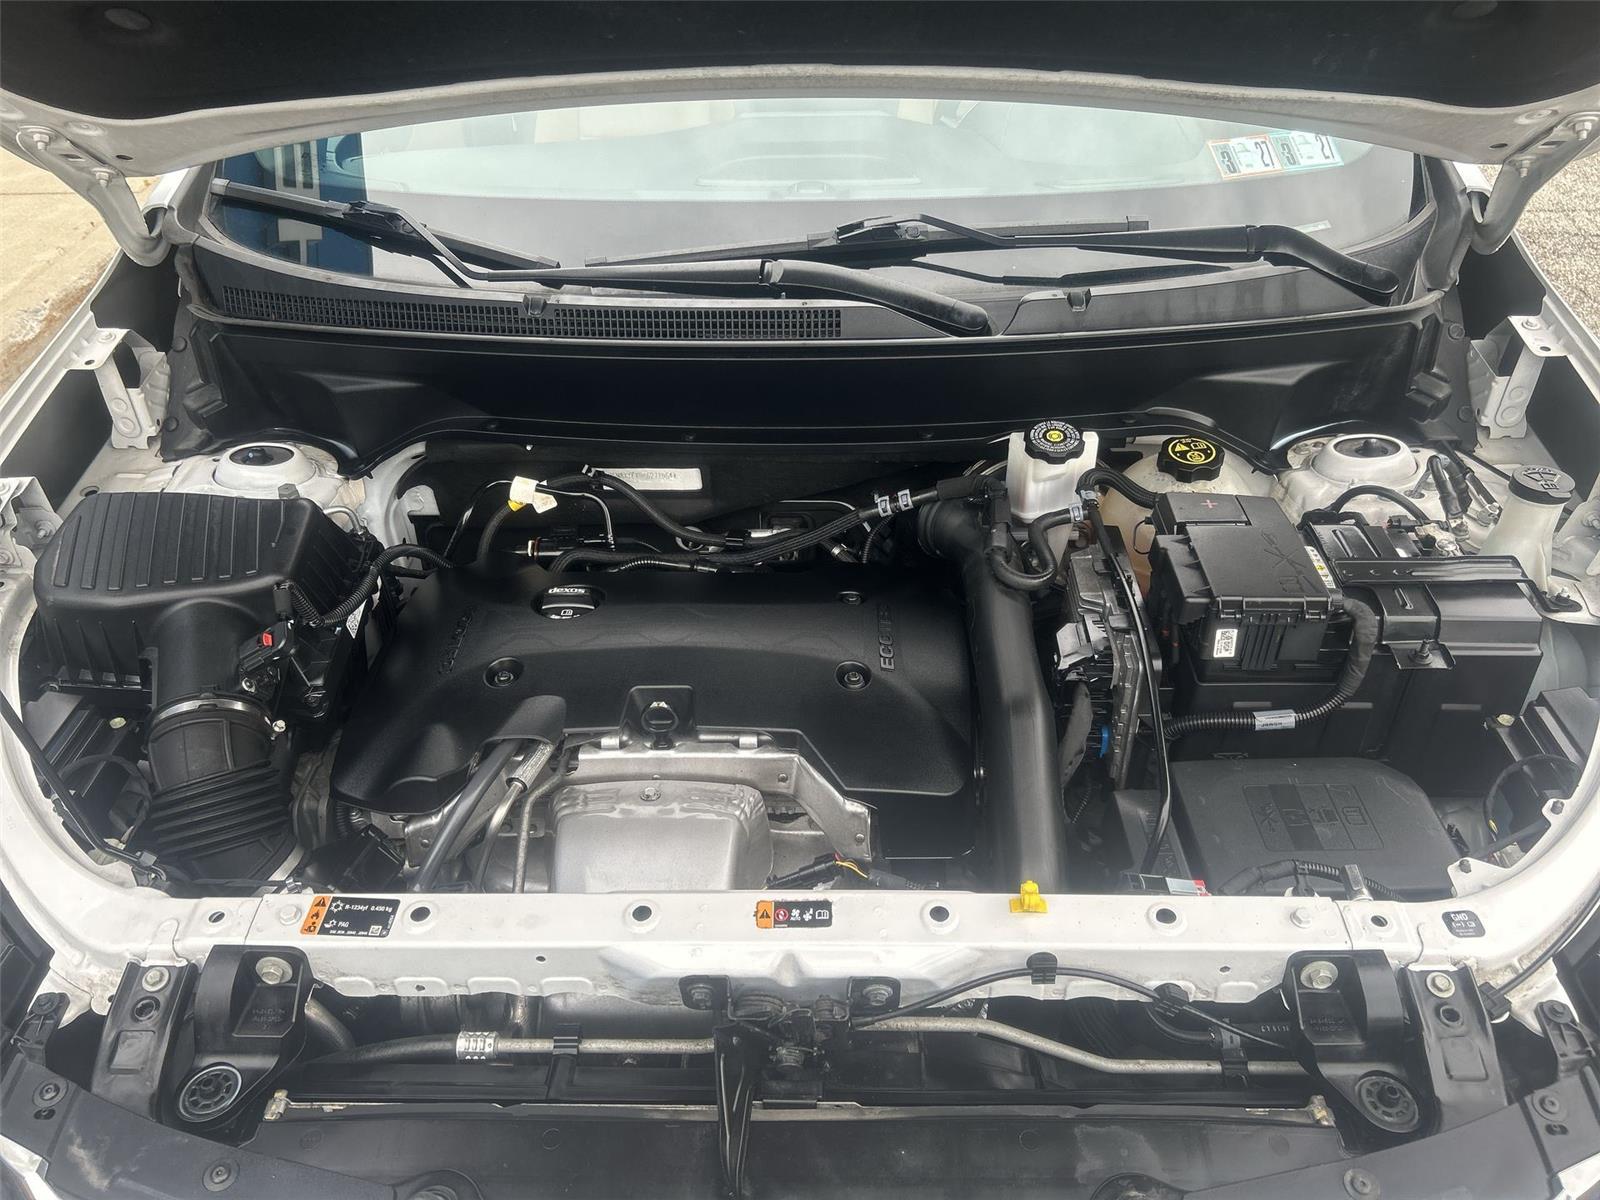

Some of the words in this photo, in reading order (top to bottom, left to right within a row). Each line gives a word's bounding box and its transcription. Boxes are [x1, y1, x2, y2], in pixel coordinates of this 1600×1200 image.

[1220, 151, 1238, 174] 3
[1254, 140, 1275, 168] 27
[1280, 142, 1297, 166] 3
